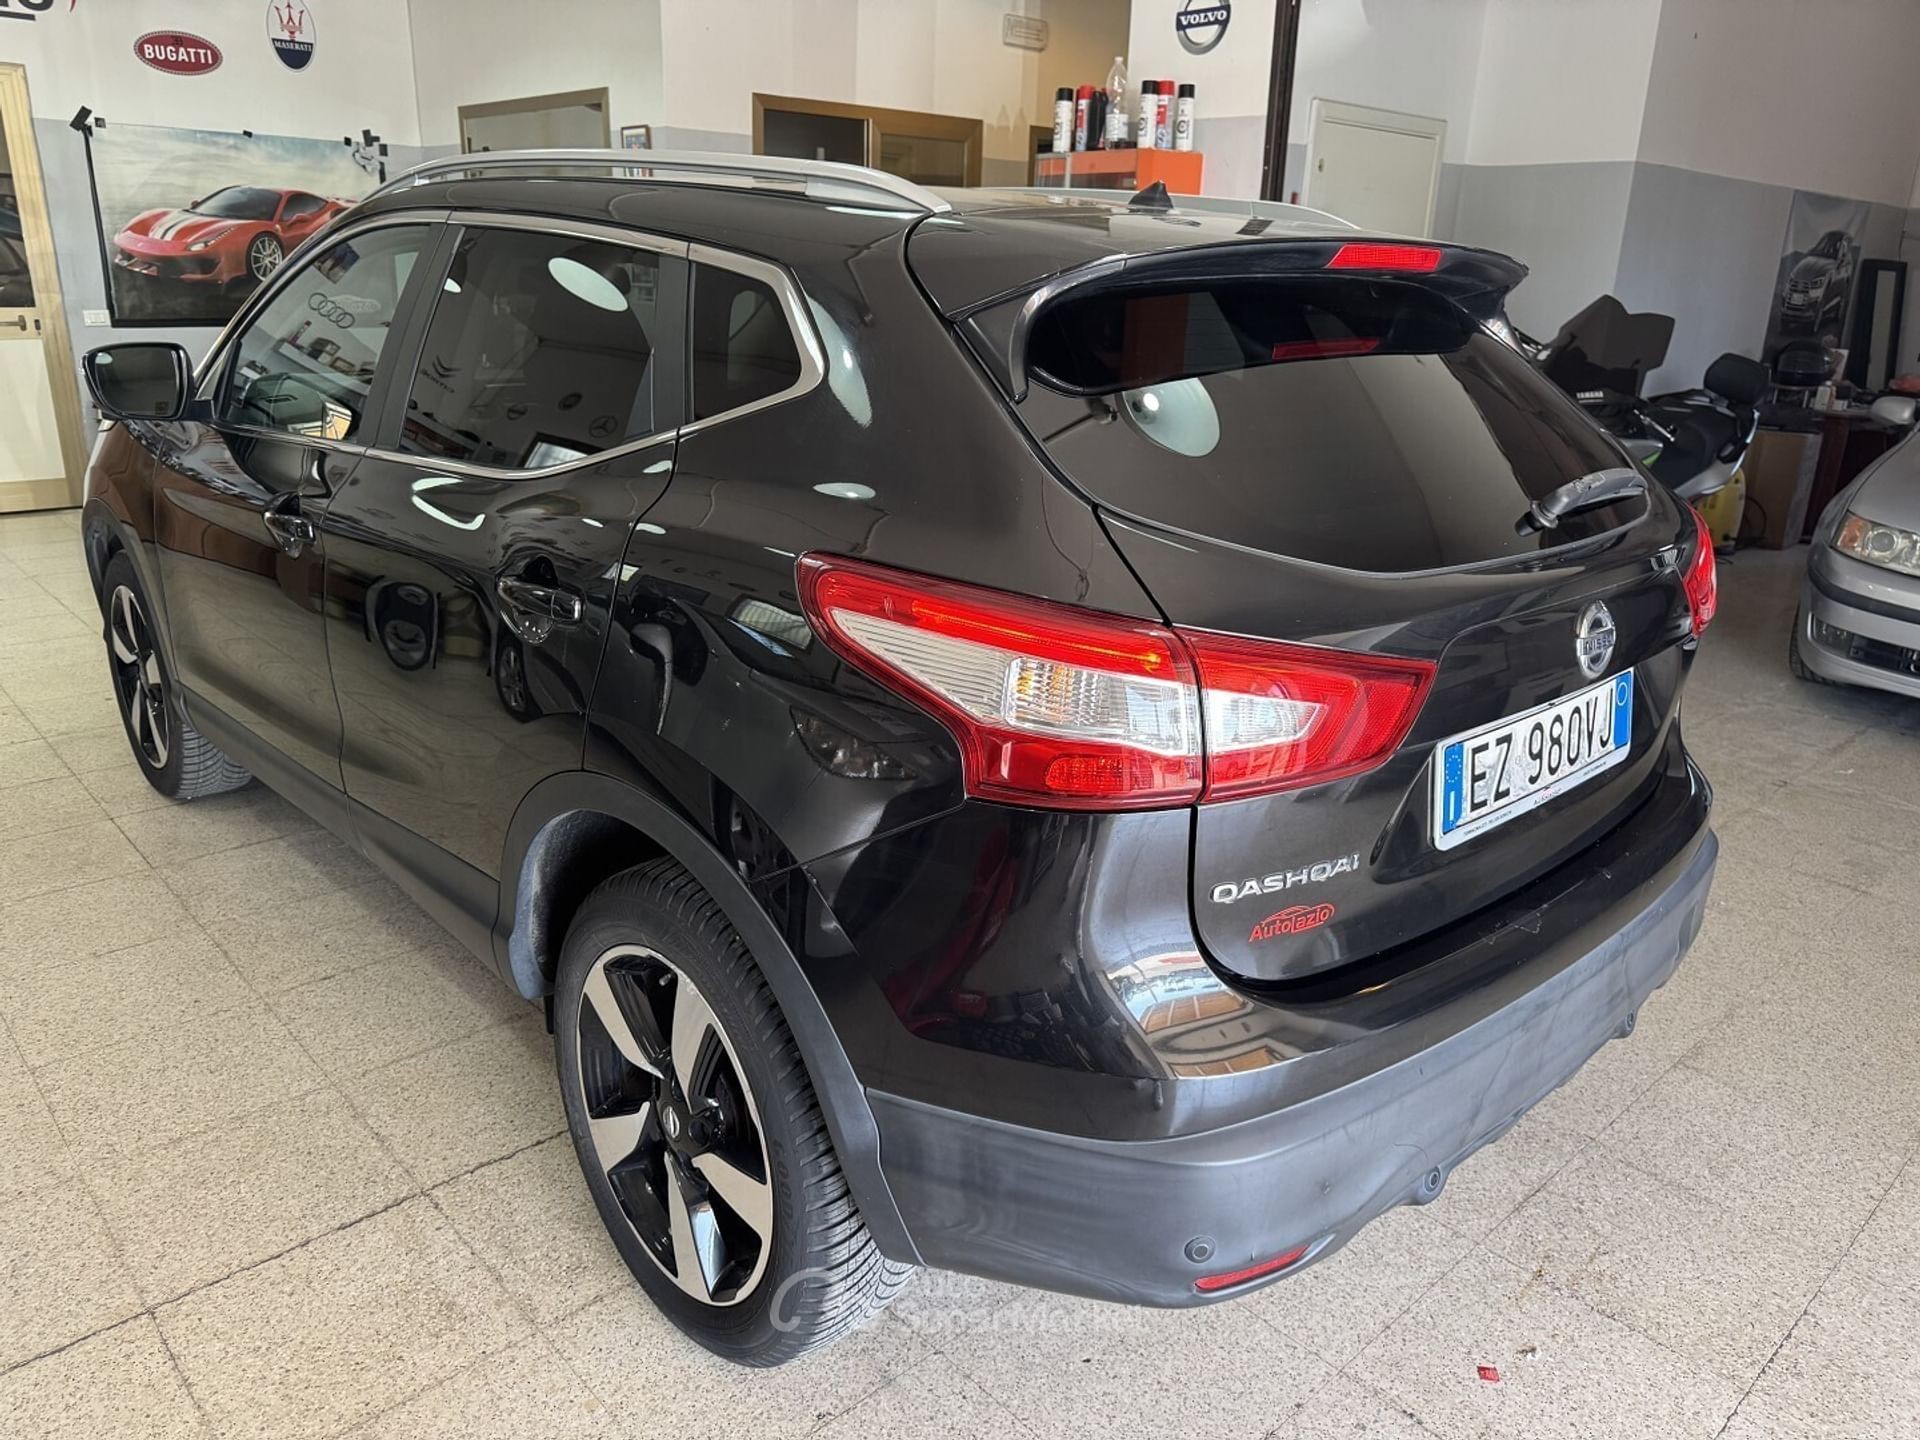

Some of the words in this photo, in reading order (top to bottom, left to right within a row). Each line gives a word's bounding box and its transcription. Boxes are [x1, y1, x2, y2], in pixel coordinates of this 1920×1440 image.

[1179, 10, 1228, 26] VOLVO
[143, 43, 213, 65] BUGATTI
[274, 40, 313, 52] MASERATI
[1469, 731, 1513, 813] EZ
[1527, 686, 1614, 786] 980VJ
[1211, 852, 1361, 904] QASHQAI
